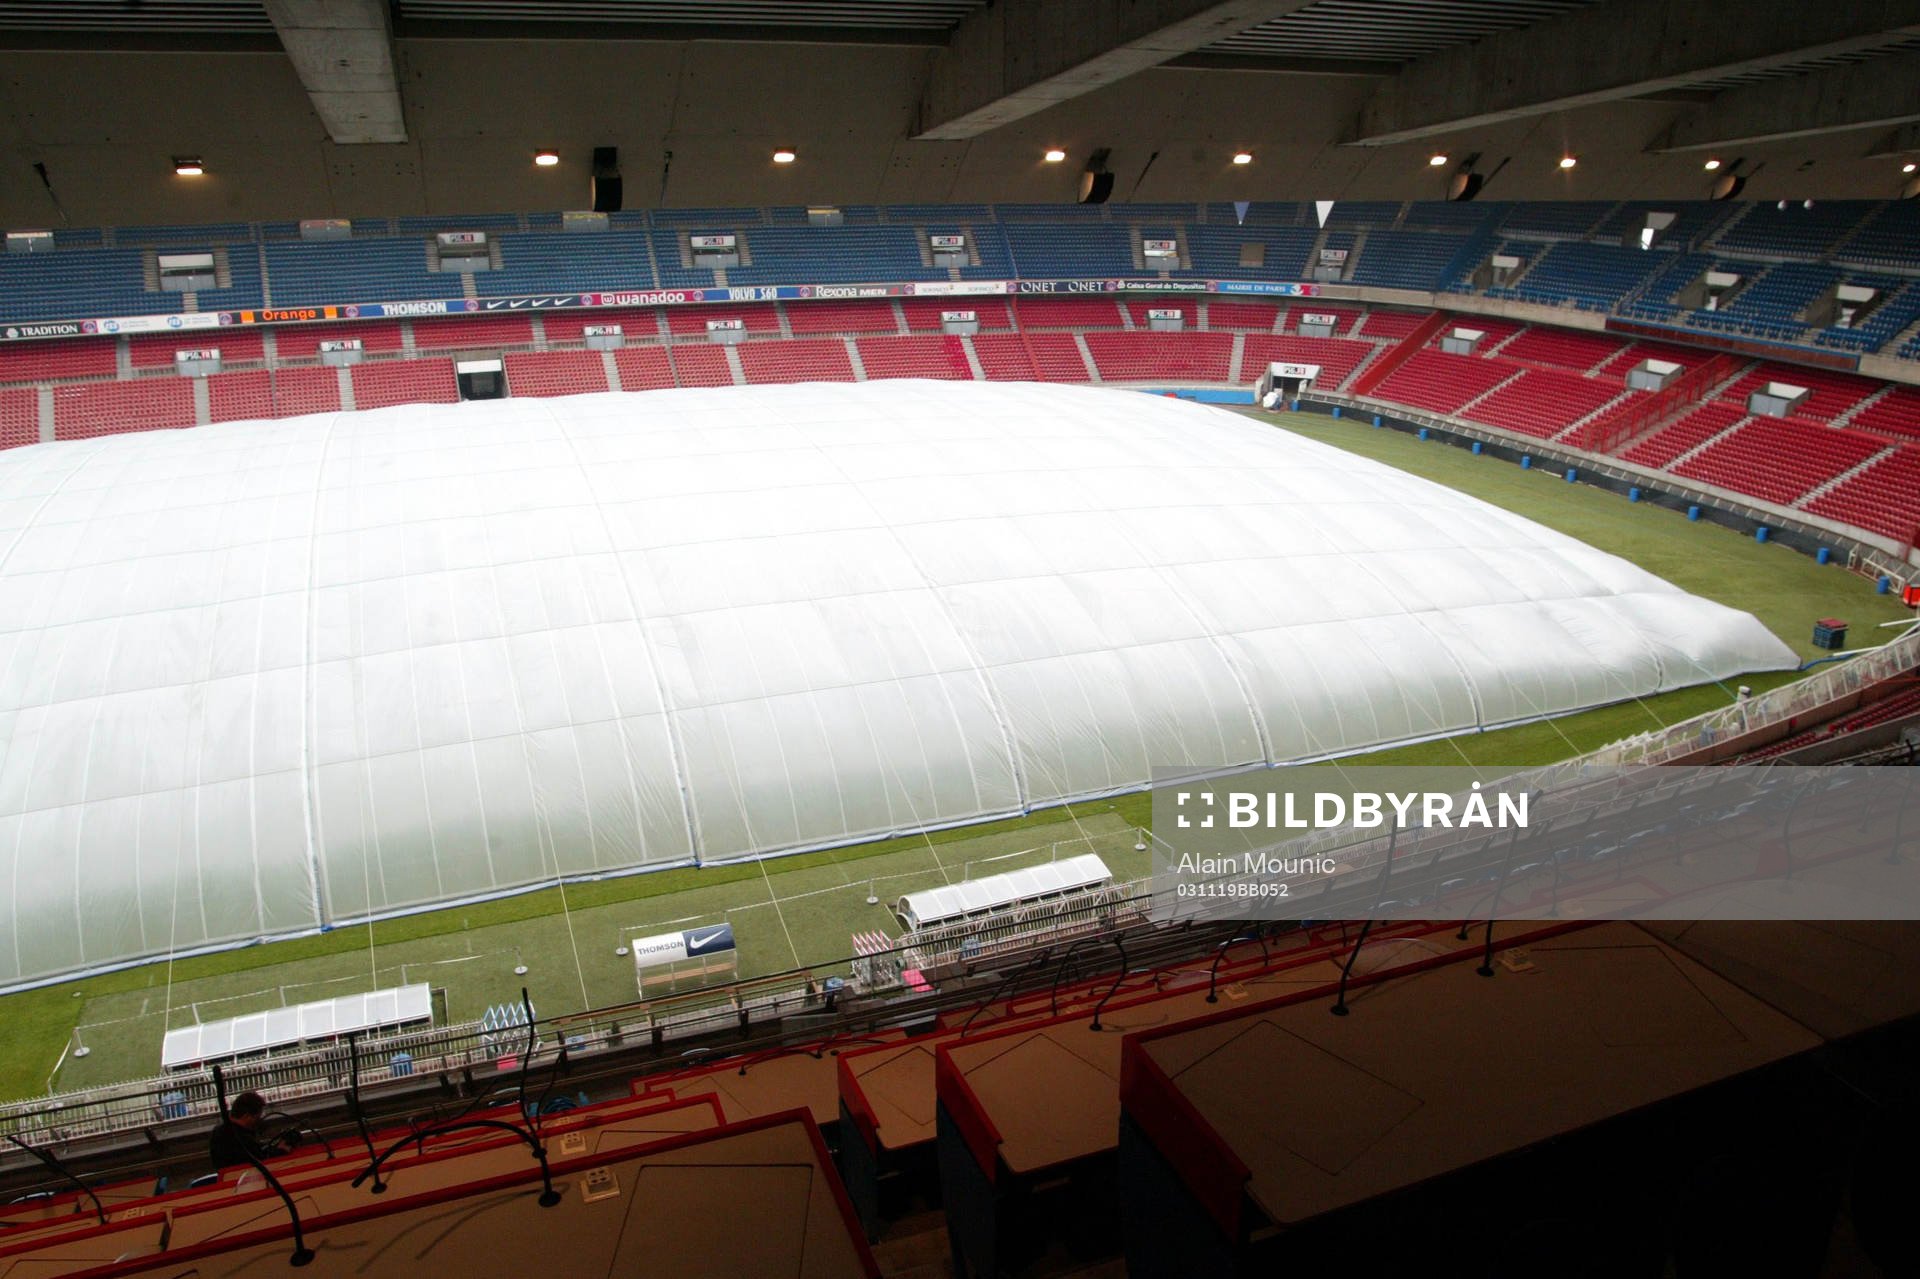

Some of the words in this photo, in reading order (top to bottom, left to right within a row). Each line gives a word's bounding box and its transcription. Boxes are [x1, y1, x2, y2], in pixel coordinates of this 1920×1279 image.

[816, 285, 857, 298] Rexona
[859, 288, 887, 297] MEN
[1126, 282, 1145, 290] Caixa
[1145, 282, 1163, 290] Geral
[1173, 283, 1206, 291] Depositos
[1253, 284, 1265, 292] DE
[616, 290, 686, 305] wanadoo
[728, 288, 756, 300] VOLVO
[760, 288, 778, 300] S60
[262, 308, 317, 321] Orange
[381, 301, 447, 316] THOMSON
[20, 324, 79, 337] TRADITION
[637, 941, 685, 955] THOMSON
